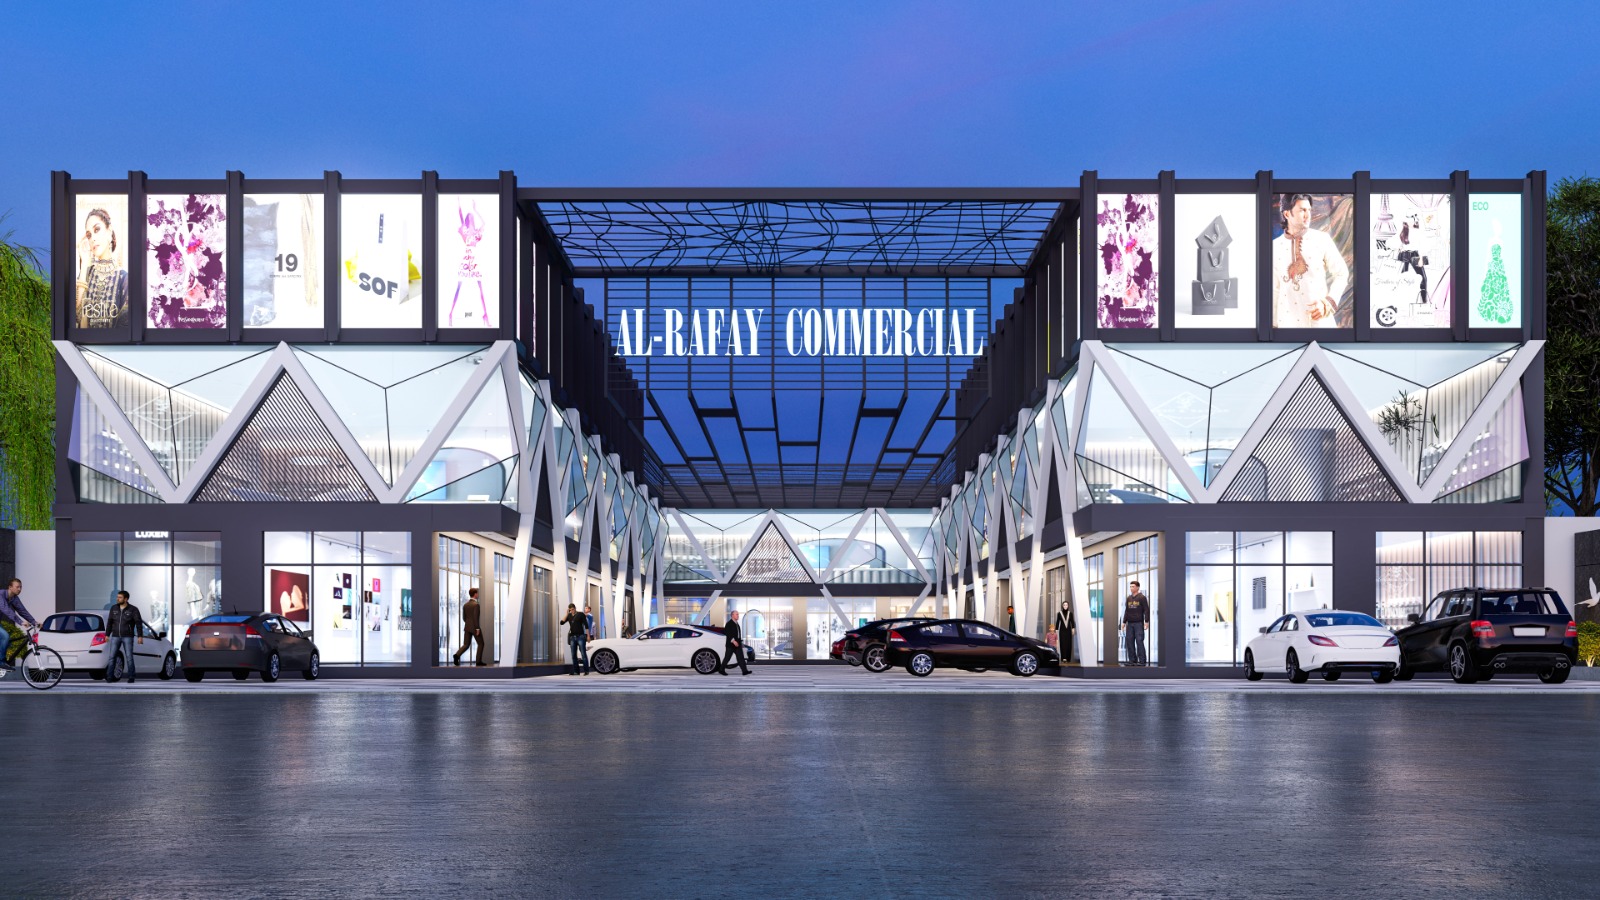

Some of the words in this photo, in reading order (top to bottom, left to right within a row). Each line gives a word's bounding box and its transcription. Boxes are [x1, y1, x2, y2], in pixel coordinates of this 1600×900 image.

[1472, 201, 1488, 210] ECO
[274, 253, 298, 272] 19
[358, 272, 398, 299] SOF
[614, 308, 764, 356] AL-RAFAY
[785, 308, 984, 356] COMMERCIAL
[135, 530, 169, 538] LUXEN
